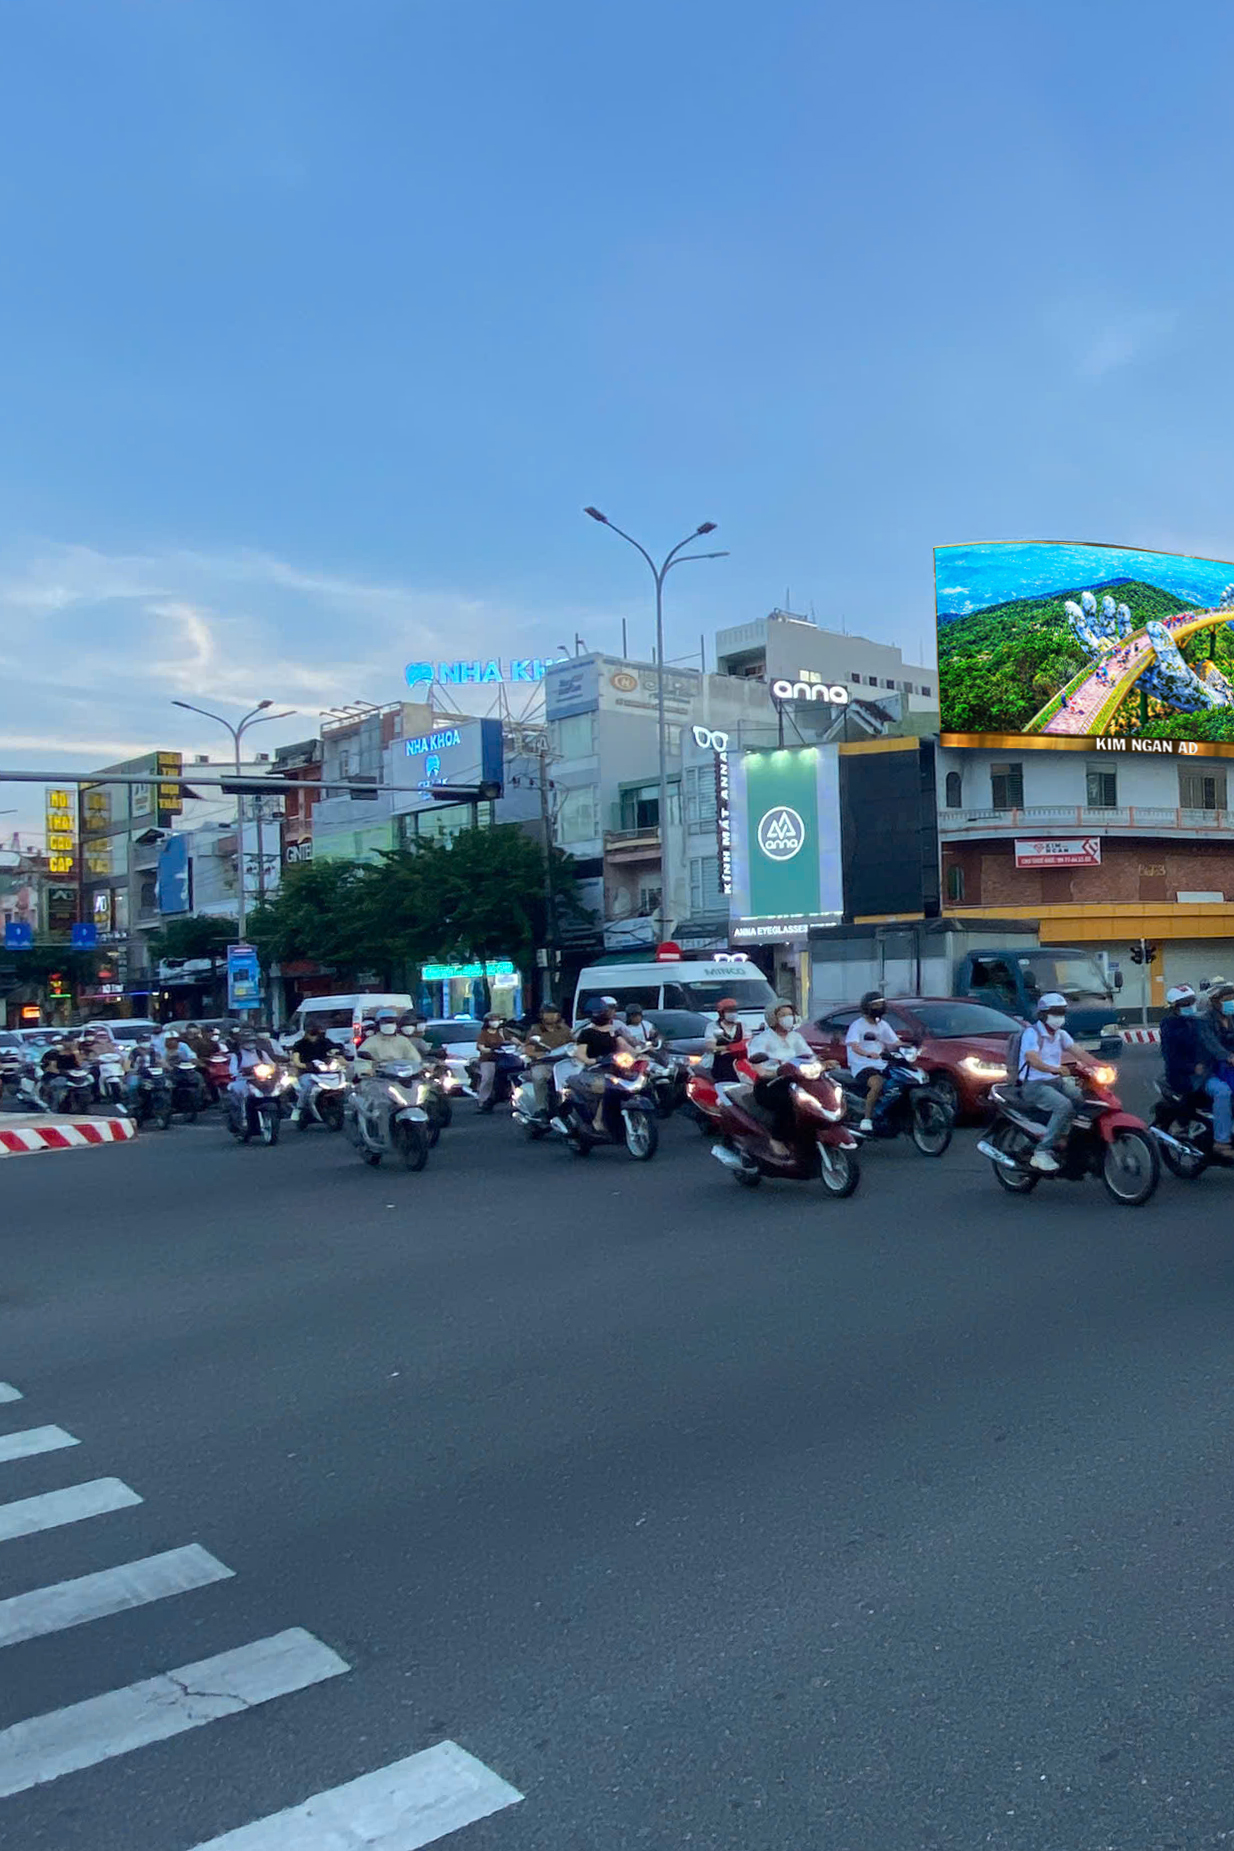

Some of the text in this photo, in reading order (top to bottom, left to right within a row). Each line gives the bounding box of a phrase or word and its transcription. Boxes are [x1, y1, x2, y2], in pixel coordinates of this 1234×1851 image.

[438, 660, 503, 684] NHA
[510, 658, 569, 682] KH
[773, 680, 848, 704] anna
[406, 729, 461, 756] NHA KHOA
[1096, 737, 1199, 754] KIM NGAN AD
[720, 751, 729, 801] ANNA
[765, 839, 798, 850] anna
[734, 927, 756, 937] ANNA
